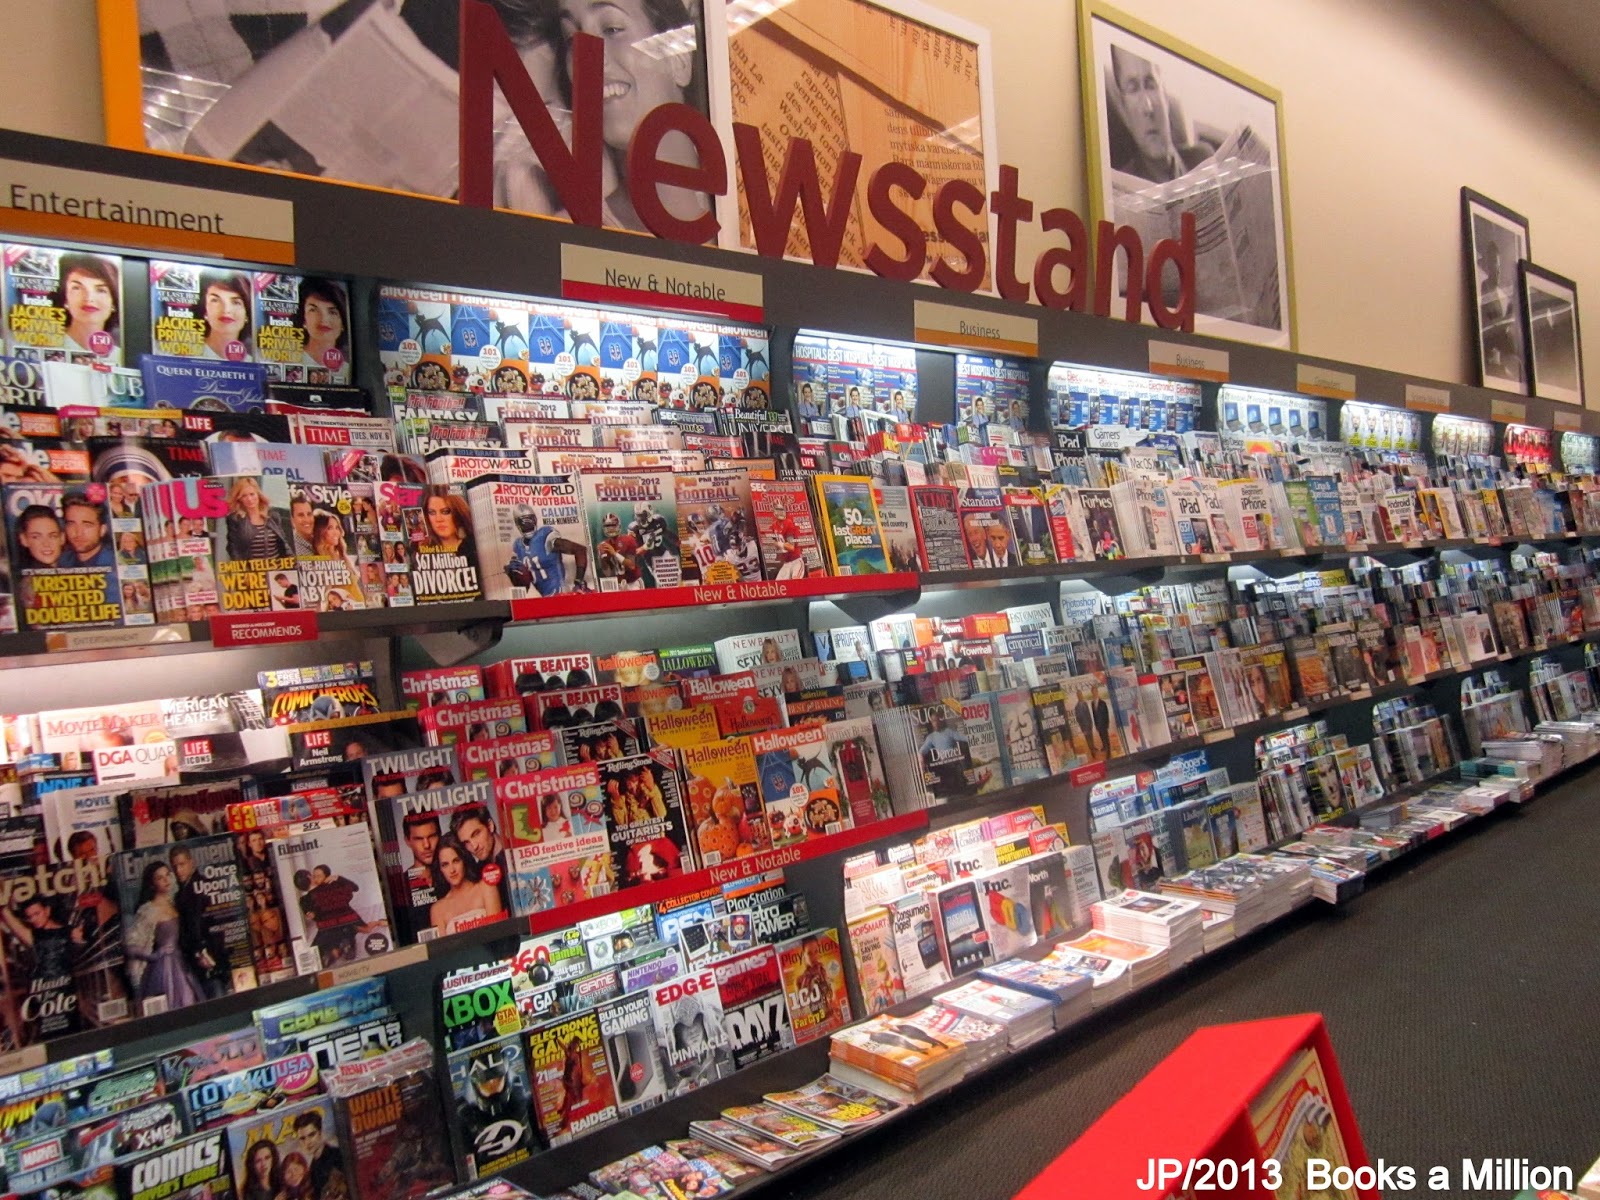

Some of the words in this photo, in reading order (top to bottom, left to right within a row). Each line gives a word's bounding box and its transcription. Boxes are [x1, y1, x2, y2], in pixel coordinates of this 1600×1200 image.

[793, 80, 832, 132] senteras
[458, 0, 1197, 333] Newsstand
[10, 183, 225, 235] Entertainment
[604, 266, 641, 291] New
[647, 273, 660, 293] &
[665, 278, 726, 301] Notable
[23, 294, 53, 306] Inside
[167, 306, 194, 318] Inside
[156, 317, 206, 332] JACKIE'S
[269, 316, 293, 327] Inside
[960, 320, 1001, 339] Business
[157, 330, 206, 344] PRIVATE
[258, 325, 305, 340] JACKIE'S
[259, 338, 304, 350] PRIVATE
[402, 343, 418, 351] 101
[483, 348, 498, 356] 101
[626, 361, 640, 369] 101
[1176, 353, 1205, 370] Business
[156, 365, 193, 377] QUEEN
[195, 369, 246, 381] ELIZABETH
[660, 411, 677, 420] SEC
[185, 417, 213, 431] LIFE
[563, 428, 581, 436] 2012
[519, 431, 583, 447] FOOTBALL
[1058, 433, 1080, 447] iPad
[1094, 428, 1121, 440] Gamers
[256, 450, 287, 461] TIME
[595, 456, 613, 465] 2012
[801, 456, 816, 468] LIFE
[1054, 453, 1085, 467] iPhone
[51, 460, 88, 474] SPECIAL
[714, 460, 730, 470] SEC
[698, 475, 712, 484] Phil
[750, 483, 766, 492] SEC
[502, 483, 575, 495] ROTOWORLD
[675, 487, 738, 501] FOOTBALL
[495, 496, 529, 506] FANTASY
[532, 496, 577, 506] FOOTBALL
[961, 496, 1001, 508] Standard
[1081, 494, 1113, 509] Forbes
[1180, 498, 1200, 514] iPad
[1242, 498, 1267, 510] iPhone
[541, 507, 578, 518] CALVIN
[843, 508, 862, 525] 50
[833, 525, 851, 536] last
[850, 525, 878, 536] GREAT
[845, 535, 873, 546] places
[416, 556, 432, 570] $67
[433, 555, 468, 570] Million
[33, 573, 108, 591] KRISTEN'S
[413, 567, 478, 595] DIVORCE!
[39, 591, 106, 607] TWISTED
[223, 590, 270, 609] DONE!
[694, 587, 724, 602] New
[726, 585, 737, 599] &
[740, 581, 788, 599] Notable
[1062, 598, 1096, 609] Photoshop
[27, 605, 89, 624] DOUBLE
[90, 603, 121, 620] LIFE
[231, 625, 302, 639] RECOMMENDS
[514, 660, 538, 675] THE
[540, 656, 590, 673] BEATLES
[402, 672, 480, 695] Christmas
[690, 676, 755, 697] Halloween
[271, 689, 317, 717] COMIC
[319, 683, 380, 707] HEROES
[541, 692, 564, 708] THE
[567, 687, 619, 707] BEATLES
[963, 703, 991, 721] oney
[1009, 710, 1034, 741] 25
[305, 732, 331, 747] LIFE
[753, 727, 823, 752] Halloween
[184, 741, 210, 756] LIFE
[312, 748, 330, 757] Neil
[466, 736, 552, 765] Christmas
[686, 741, 751, 766] Halloween
[185, 754, 212, 766] ICONS
[300, 754, 344, 768] Armstrong
[370, 749, 453, 777] TWILIGHT
[505, 770, 598, 801] Christmas
[397, 781, 490, 816] TWILIGHT
[303, 821, 321, 831] SFX
[611, 821, 674, 843] GUITARISTS
[616, 824, 629, 832] 100
[630, 816, 666, 830] GREATEST
[519, 845, 541, 860] 150
[542, 841, 575, 855] festive
[576, 835, 604, 848] ideas
[204, 865, 237, 878] Once
[710, 866, 738, 884] New
[741, 862, 753, 876] &
[756, 849, 801, 872] Notable
[954, 858, 983, 875] Inc.
[193, 878, 228, 894] Upon
[229, 876, 240, 888] A
[983, 878, 1012, 895] Inc.
[208, 890, 242, 905] Time
[658, 902, 667, 914] 4
[666, 891, 700, 910] COLLECTOR
[700, 885, 723, 899] COVER
[726, 886, 785, 913] PlayStation
[896, 903, 931, 923] Consumers
[895, 918, 912, 935] Digest
[627, 960, 663, 979] NINTENDO
[578, 972, 615, 994] GAME
[656, 971, 716, 1007] EDGE
[601, 1007, 649, 1037] GAMING
[794, 1017, 807, 1029] Far
[807, 1013, 820, 1027] Cry
[820, 1010, 827, 1020] 3
[530, 1013, 598, 1047] ELECTRONIC
[202, 1063, 278, 1105] OTAKU
[276, 1057, 312, 1076] USA
[350, 1083, 401, 1113] WHITE
[352, 1102, 405, 1134] DWARF
[570, 1105, 618, 1136] RAIDER
[137, 1121, 183, 1150] X-MEN
[132, 1136, 221, 1193] COMICS
